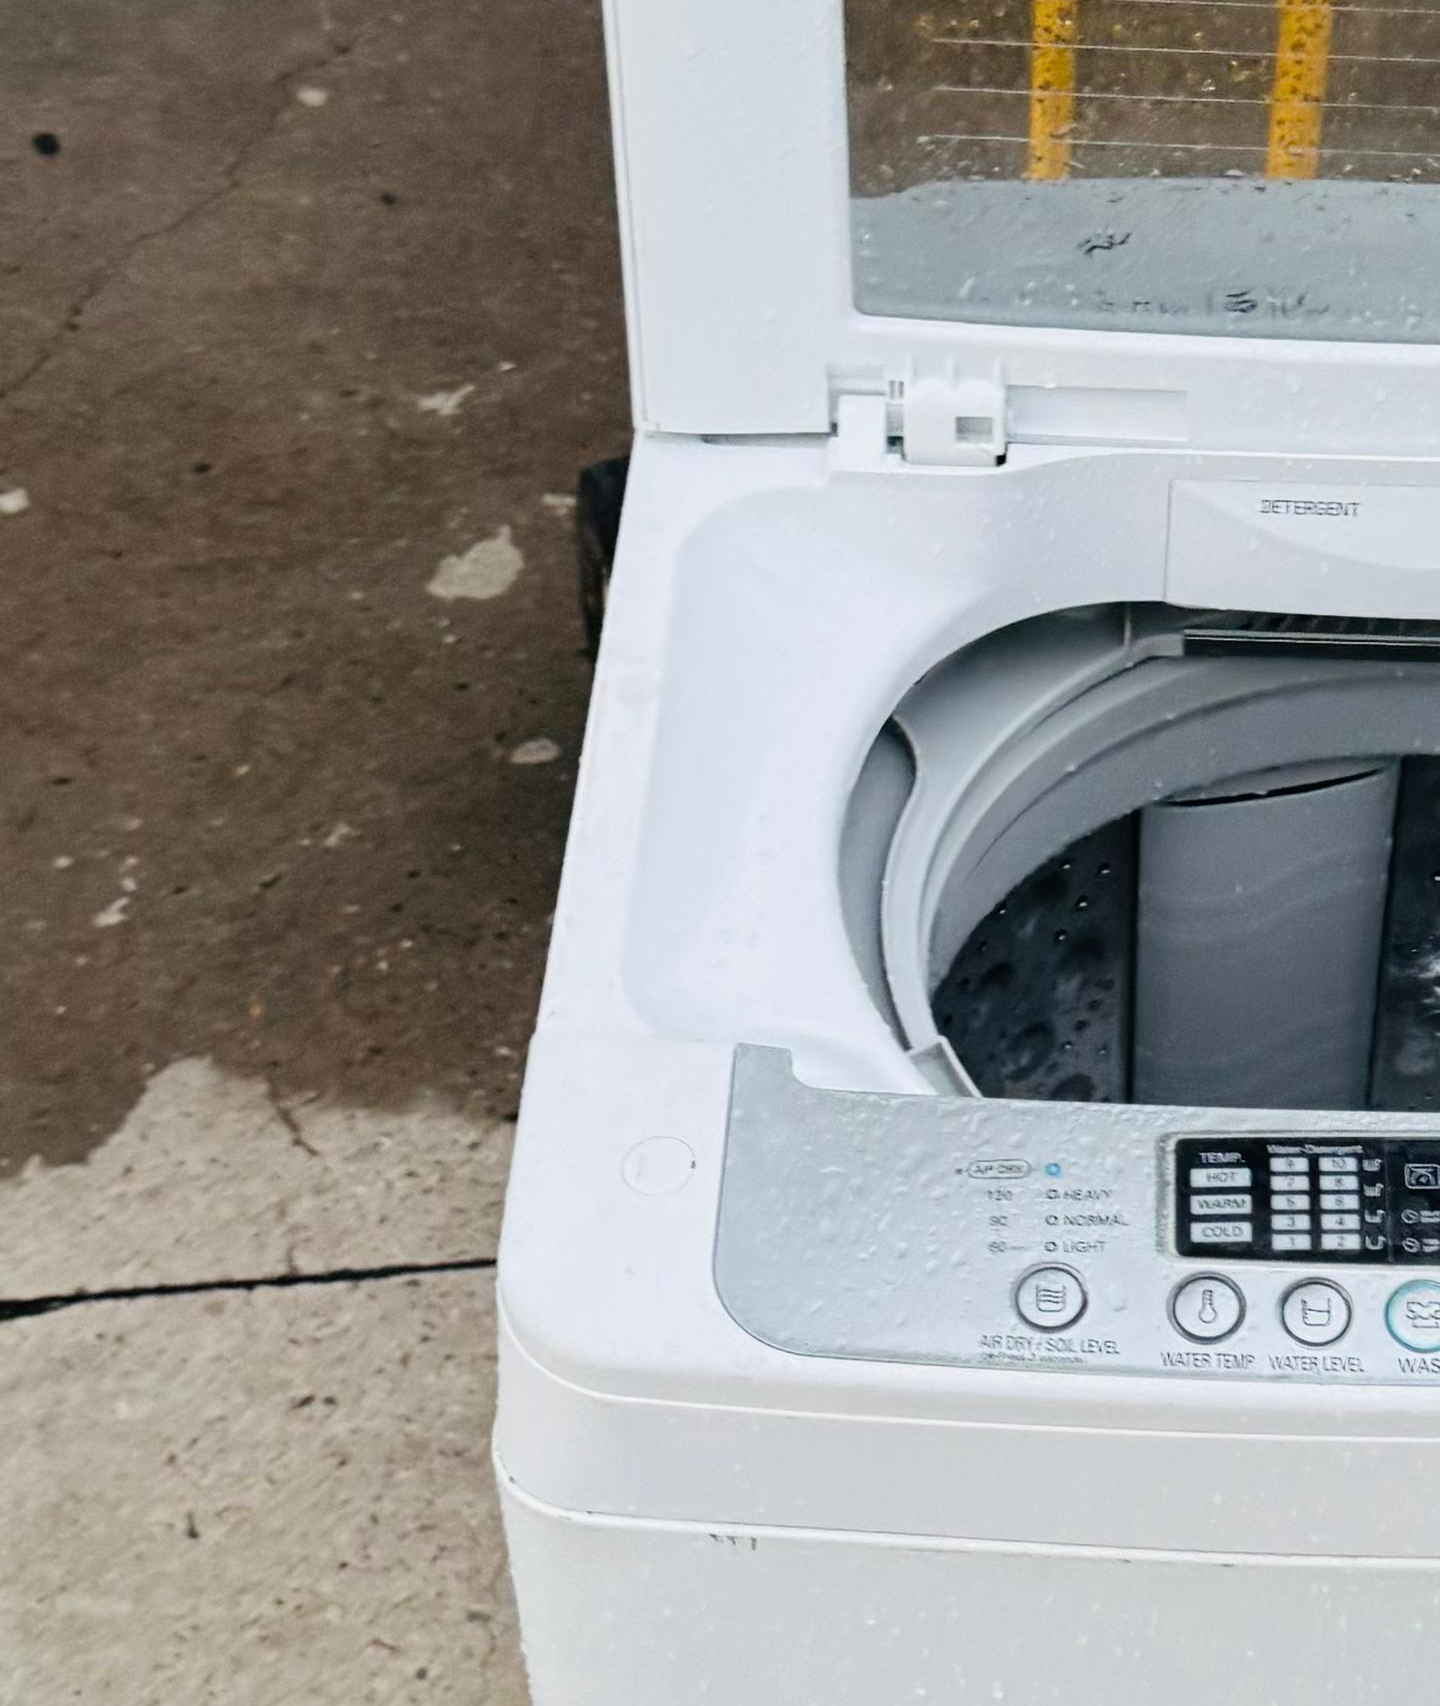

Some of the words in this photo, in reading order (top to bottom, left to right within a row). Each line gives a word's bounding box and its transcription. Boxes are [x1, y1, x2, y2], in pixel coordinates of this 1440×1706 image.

[1260, 499, 1360, 517] DETERGENT
[1206, 1171, 1239, 1183] HOT
[1063, 1189, 1113, 1201] HEAVY
[1197, 1198, 1247, 1210] WARM
[1063, 1214, 1129, 1227] NORMAL
[1201, 1225, 1244, 1238] COLD
[1063, 1241, 1107, 1253] LIGHT
[1081, 1339, 1121, 1355] LEVEL
[1160, 1351, 1211, 1368] WATER
[1268, 1354, 1319, 1372] WATER
[1322, 1356, 1366, 1373] LEVEL
